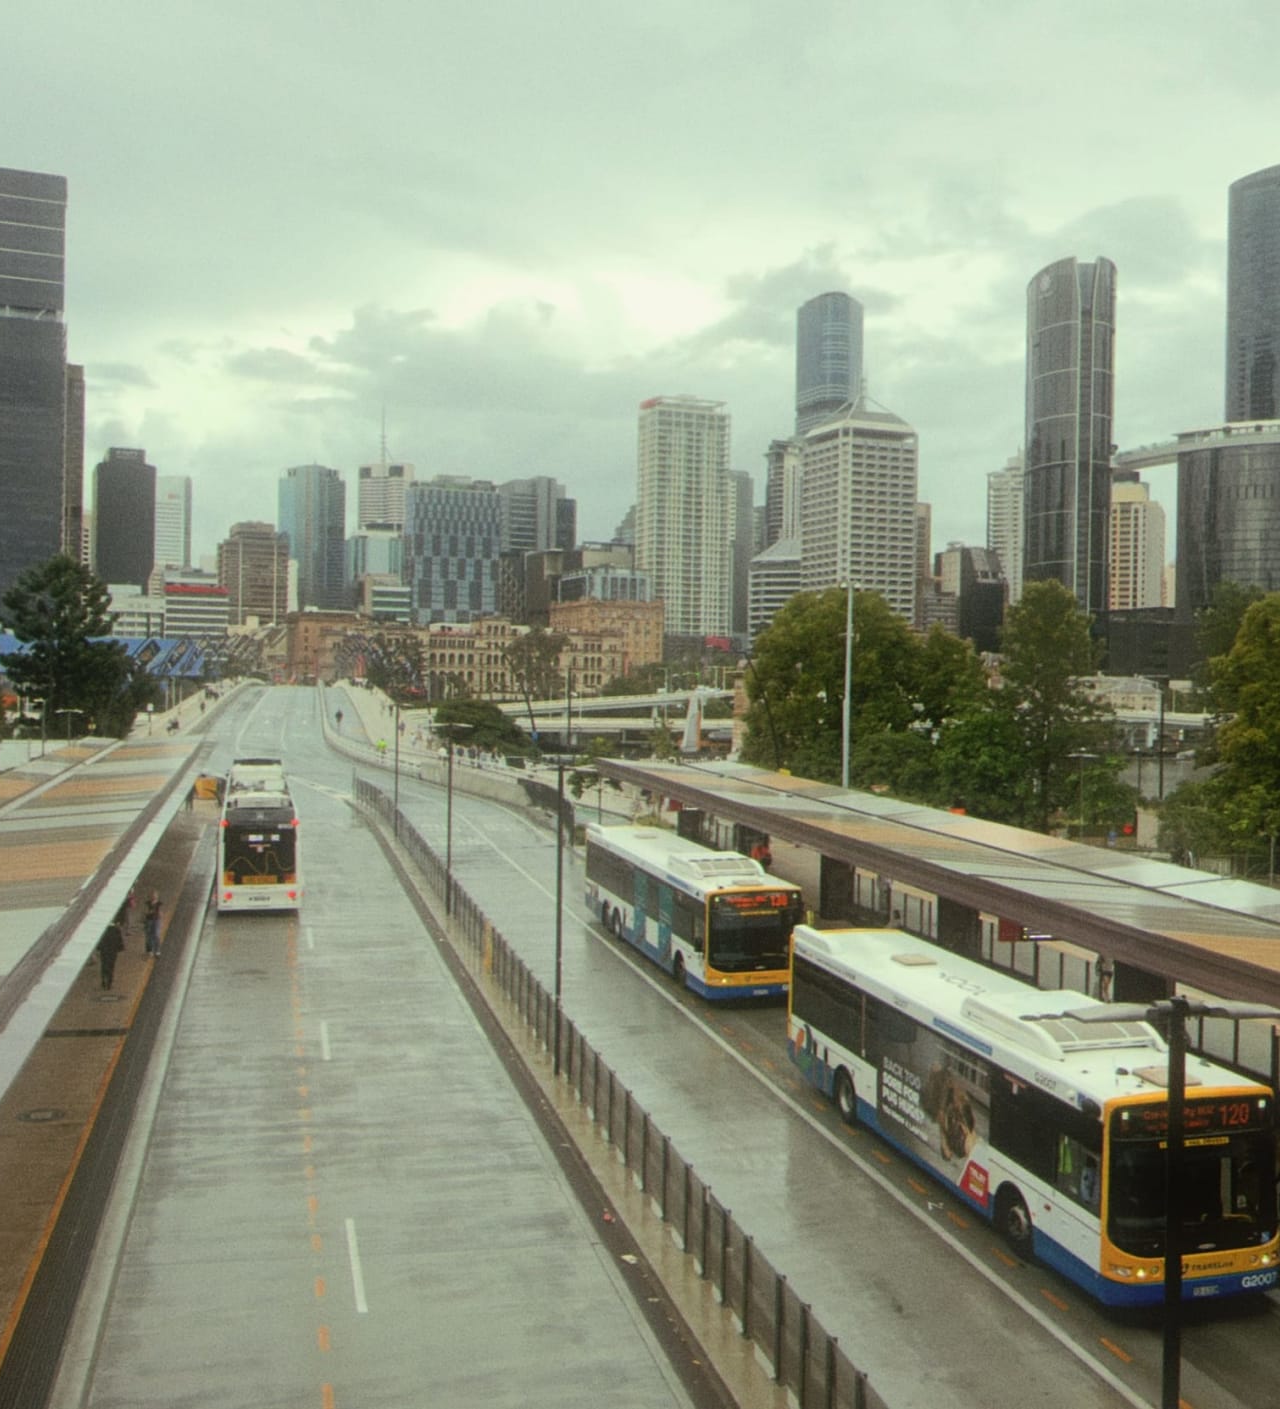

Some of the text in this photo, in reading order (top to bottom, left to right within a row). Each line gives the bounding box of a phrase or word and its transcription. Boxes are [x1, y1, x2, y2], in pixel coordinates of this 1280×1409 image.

[883, 1056, 903, 1080] BACK
[1220, 1103, 1249, 1126] 120
[1241, 1271, 1278, 1288] G2007
